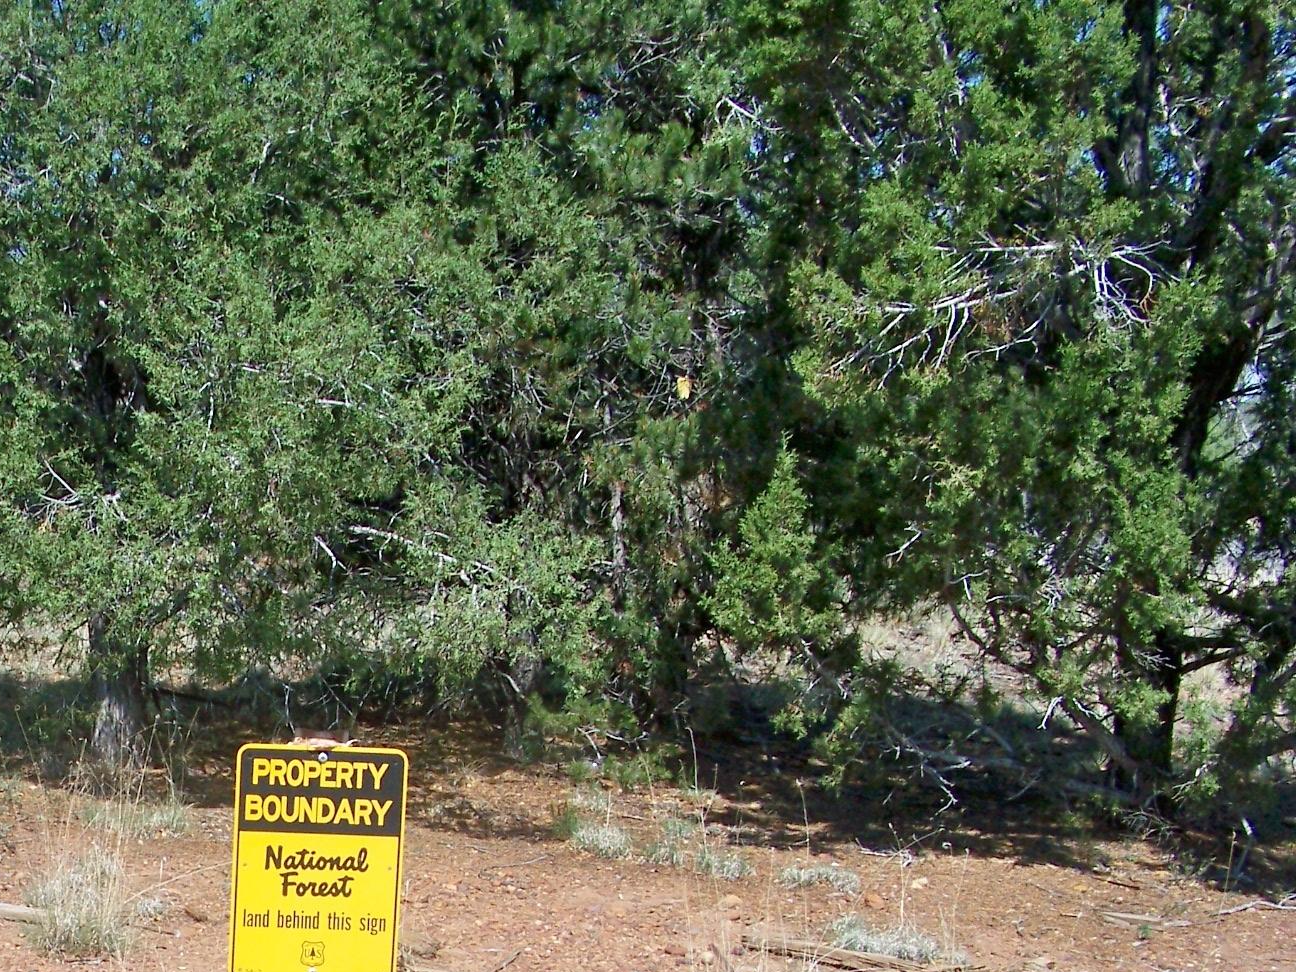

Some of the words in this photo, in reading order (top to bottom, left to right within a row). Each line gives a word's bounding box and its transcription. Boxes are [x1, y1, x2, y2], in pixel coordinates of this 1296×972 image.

[252, 758, 389, 790] PROPERTY
[244, 794, 393, 826] BOUNDARY
[265, 845, 369, 872] National
[279, 871, 354, 897] Forest
[242, 909, 270, 928] land
[277, 910, 320, 930] behind
[328, 911, 352, 931] this
[359, 913, 386, 935] sign
